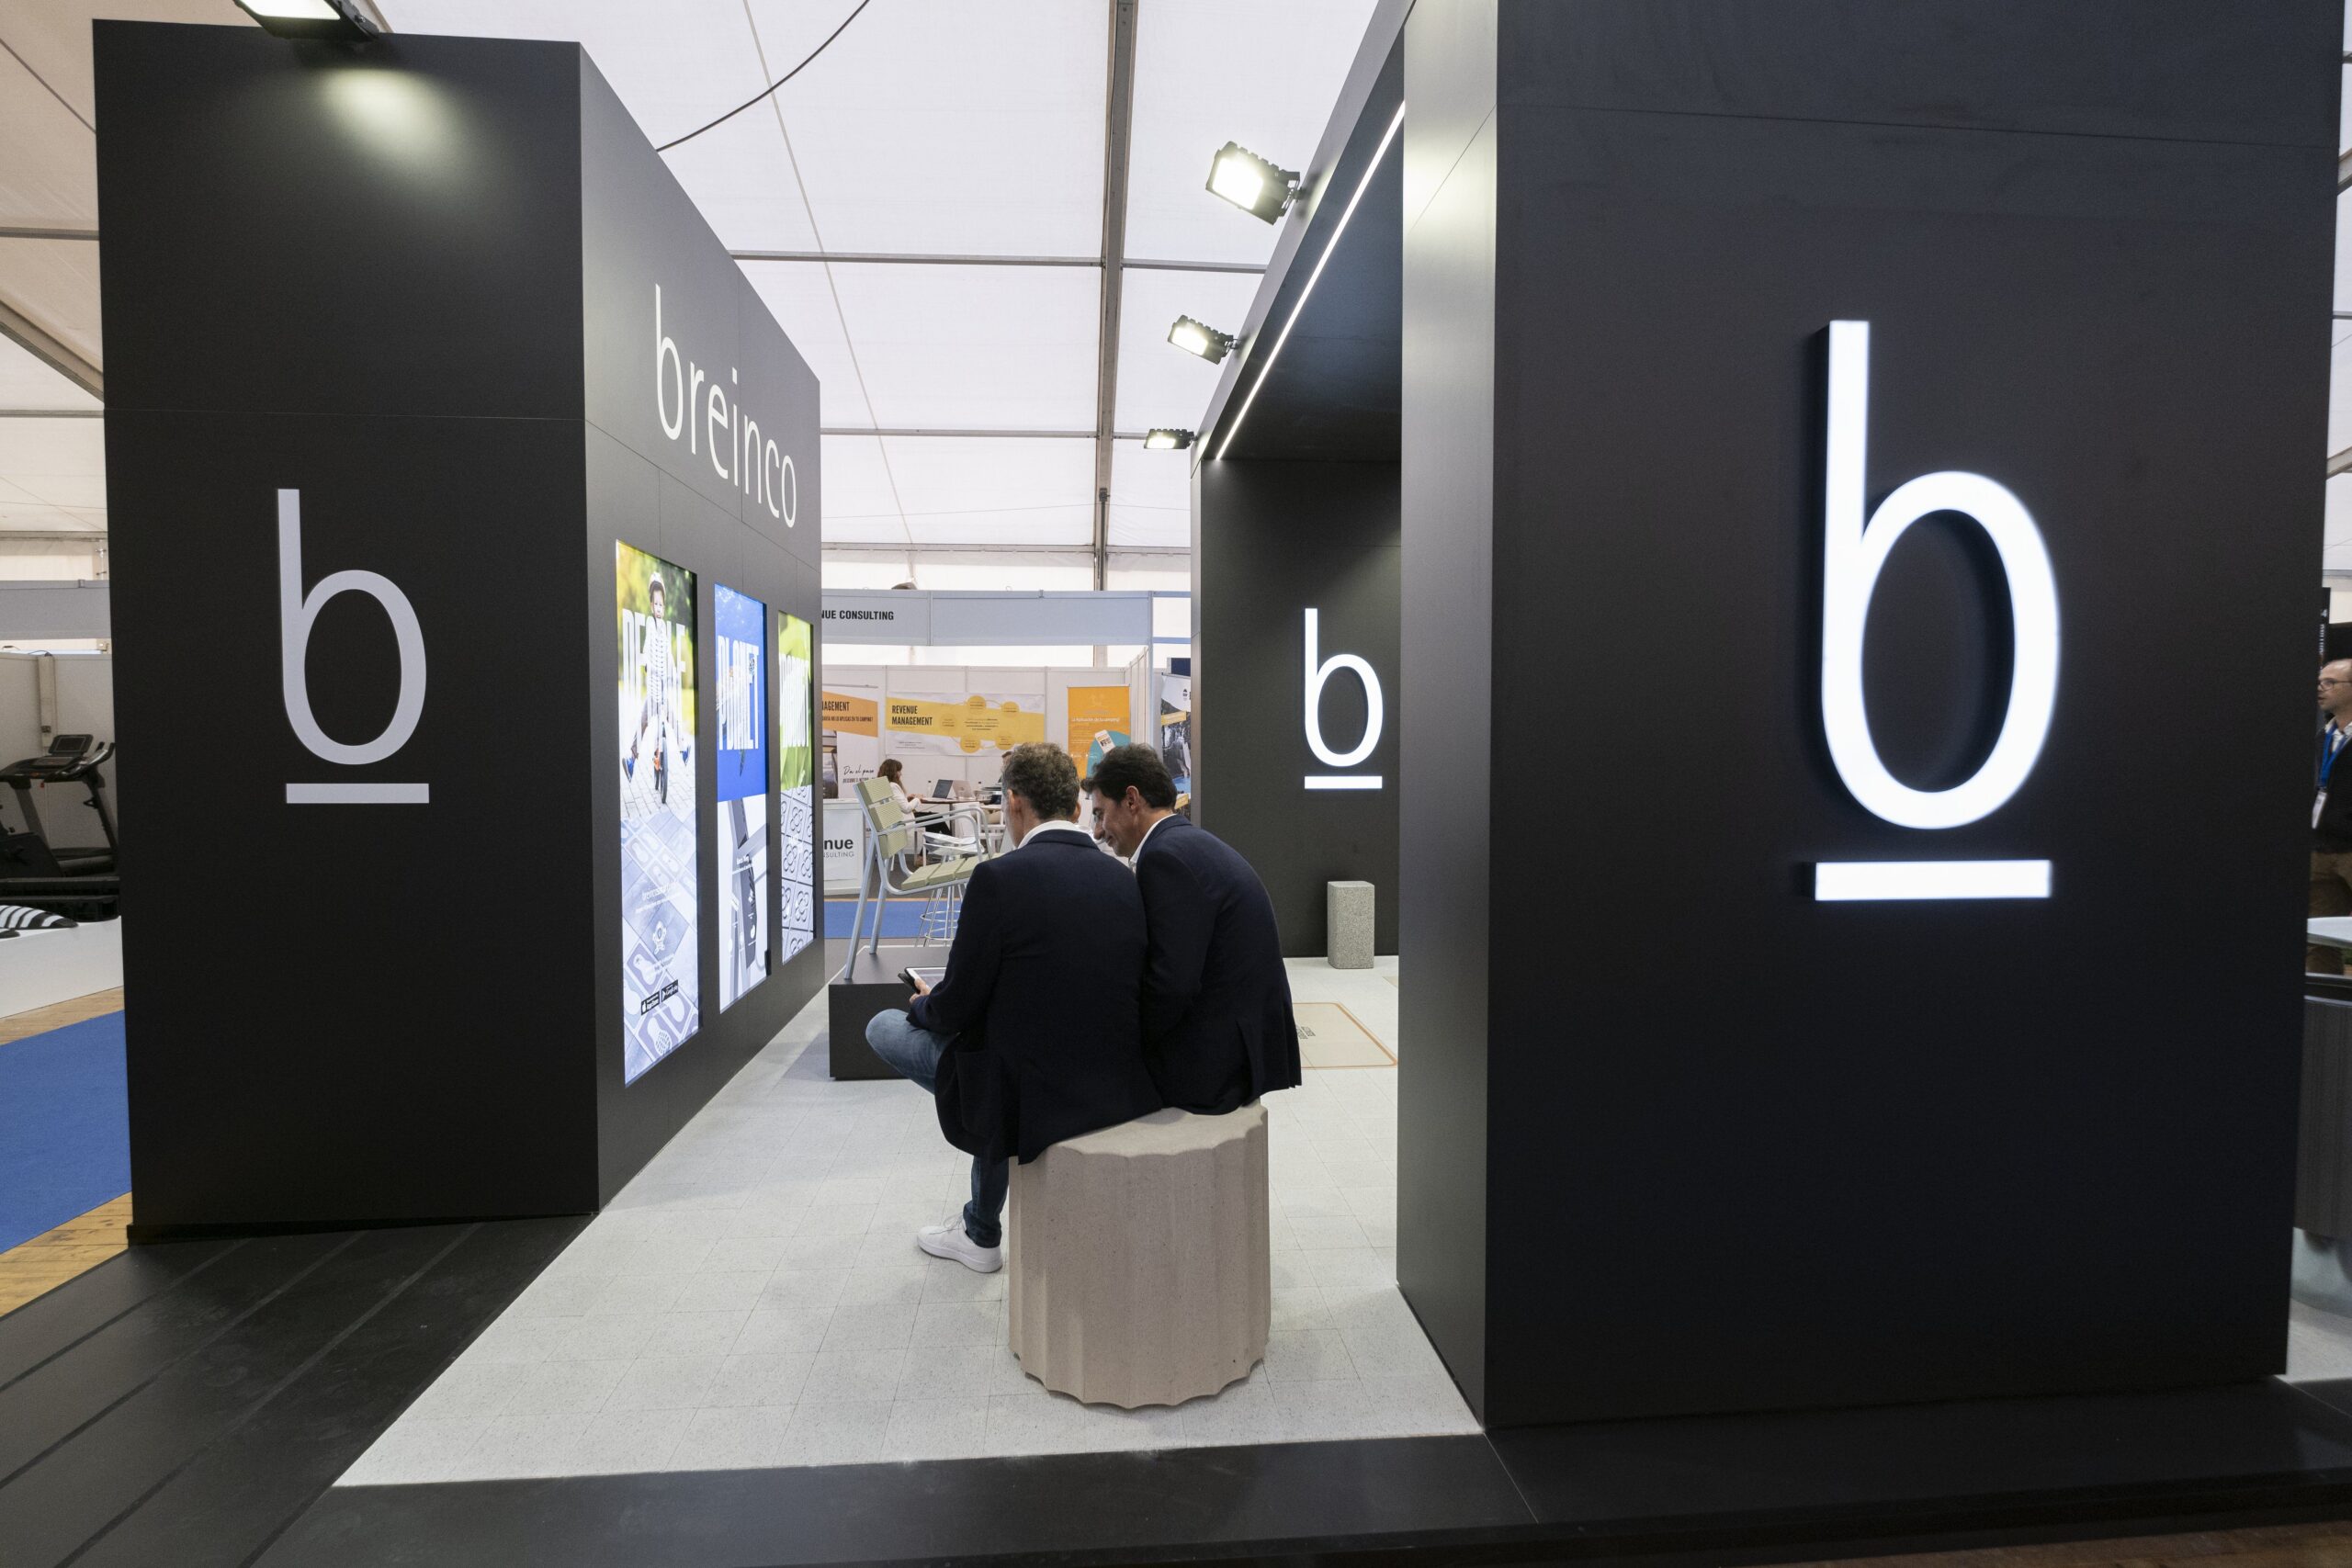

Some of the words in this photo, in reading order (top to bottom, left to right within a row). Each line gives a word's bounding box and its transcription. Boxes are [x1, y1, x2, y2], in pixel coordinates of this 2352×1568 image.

[655, 283, 797, 528] breinco
[277, 488, 427, 765] b
[839, 610, 894, 621] CONSULTING
[1821, 320, 2062, 829] b
[891, 705, 918, 715] REVENUE
[891, 716, 933, 726] MANAGEMENT
[1305, 607, 1384, 768] b
